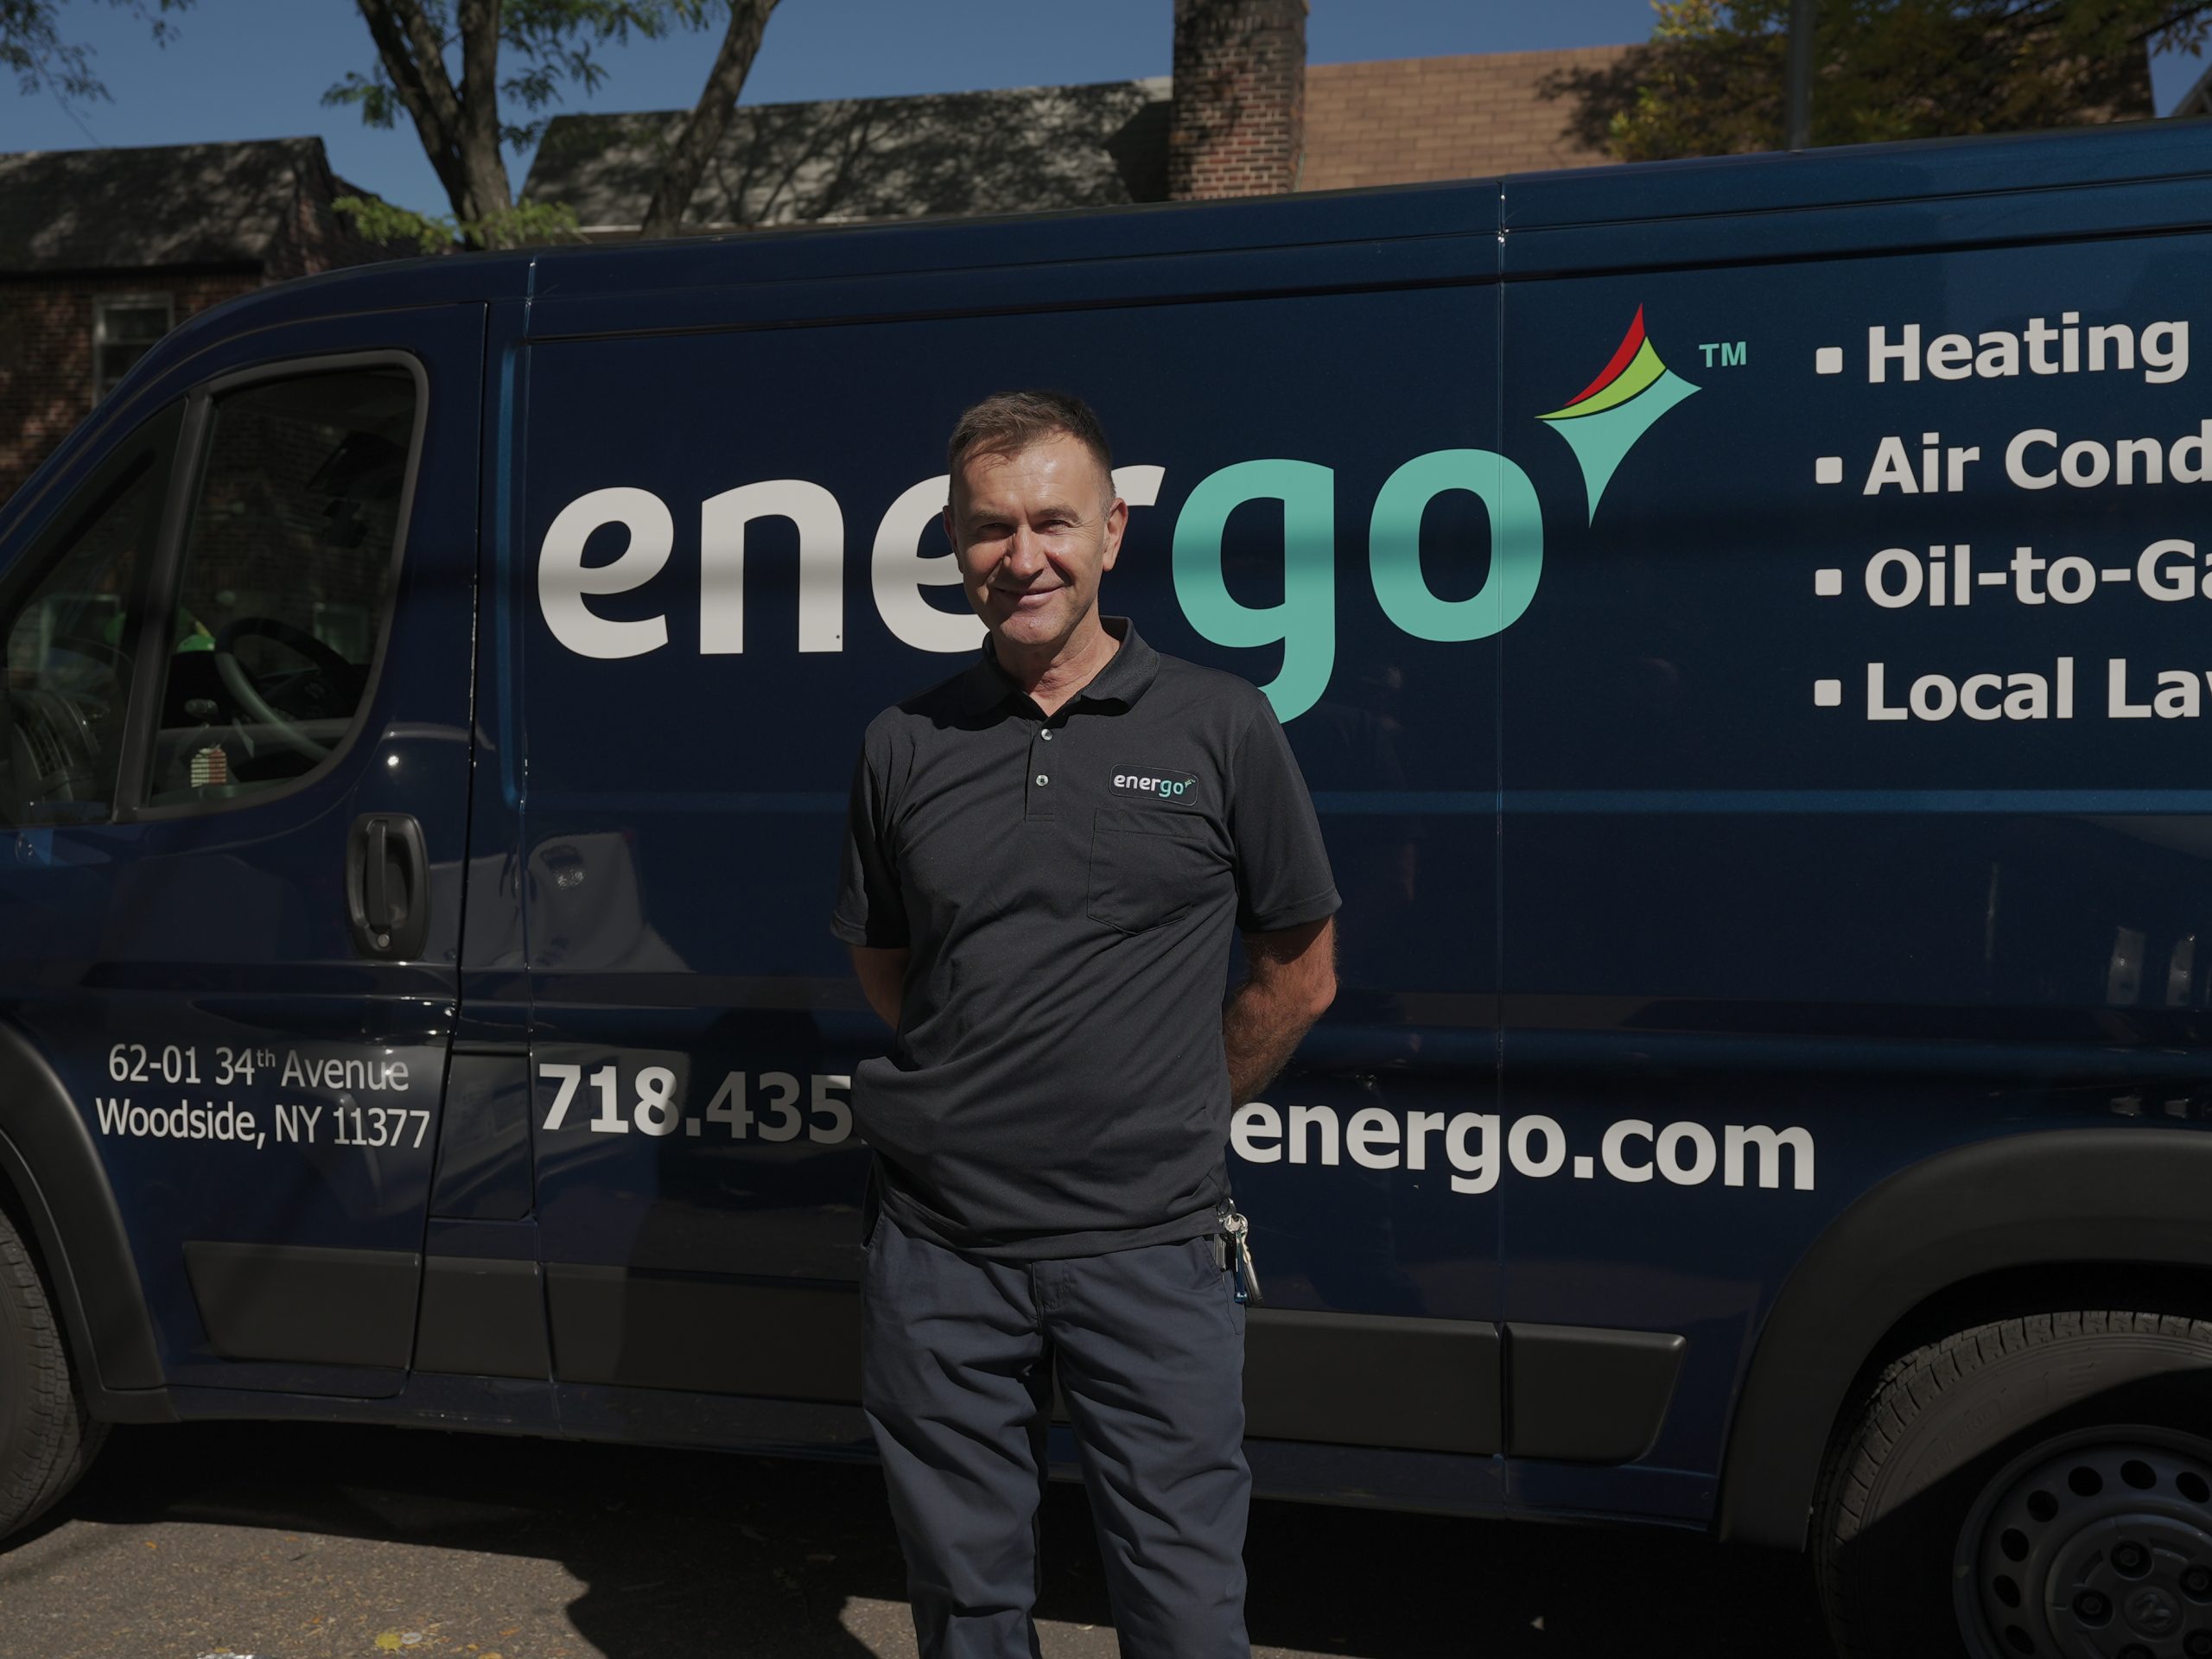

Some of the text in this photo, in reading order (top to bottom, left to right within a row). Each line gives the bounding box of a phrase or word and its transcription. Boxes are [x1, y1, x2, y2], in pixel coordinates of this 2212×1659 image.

[1698, 341, 1747, 368] TM
[1868, 311, 2190, 384] Heating
[1862, 418, 2212, 495] Air Cond
[537, 448, 1544, 725] enego
[1864, 538, 2212, 608] Oil-to-G
[1866, 656, 2212, 721] Local La
[1113, 774, 1184, 798] energo
[108, 1043, 410, 1091] 62-01 34th Avenue
[95, 1097, 431, 1150] Woodside, NY 11377
[538, 1063, 868, 1146] 718.435
[1230, 1102, 1815, 1194] energo.com
